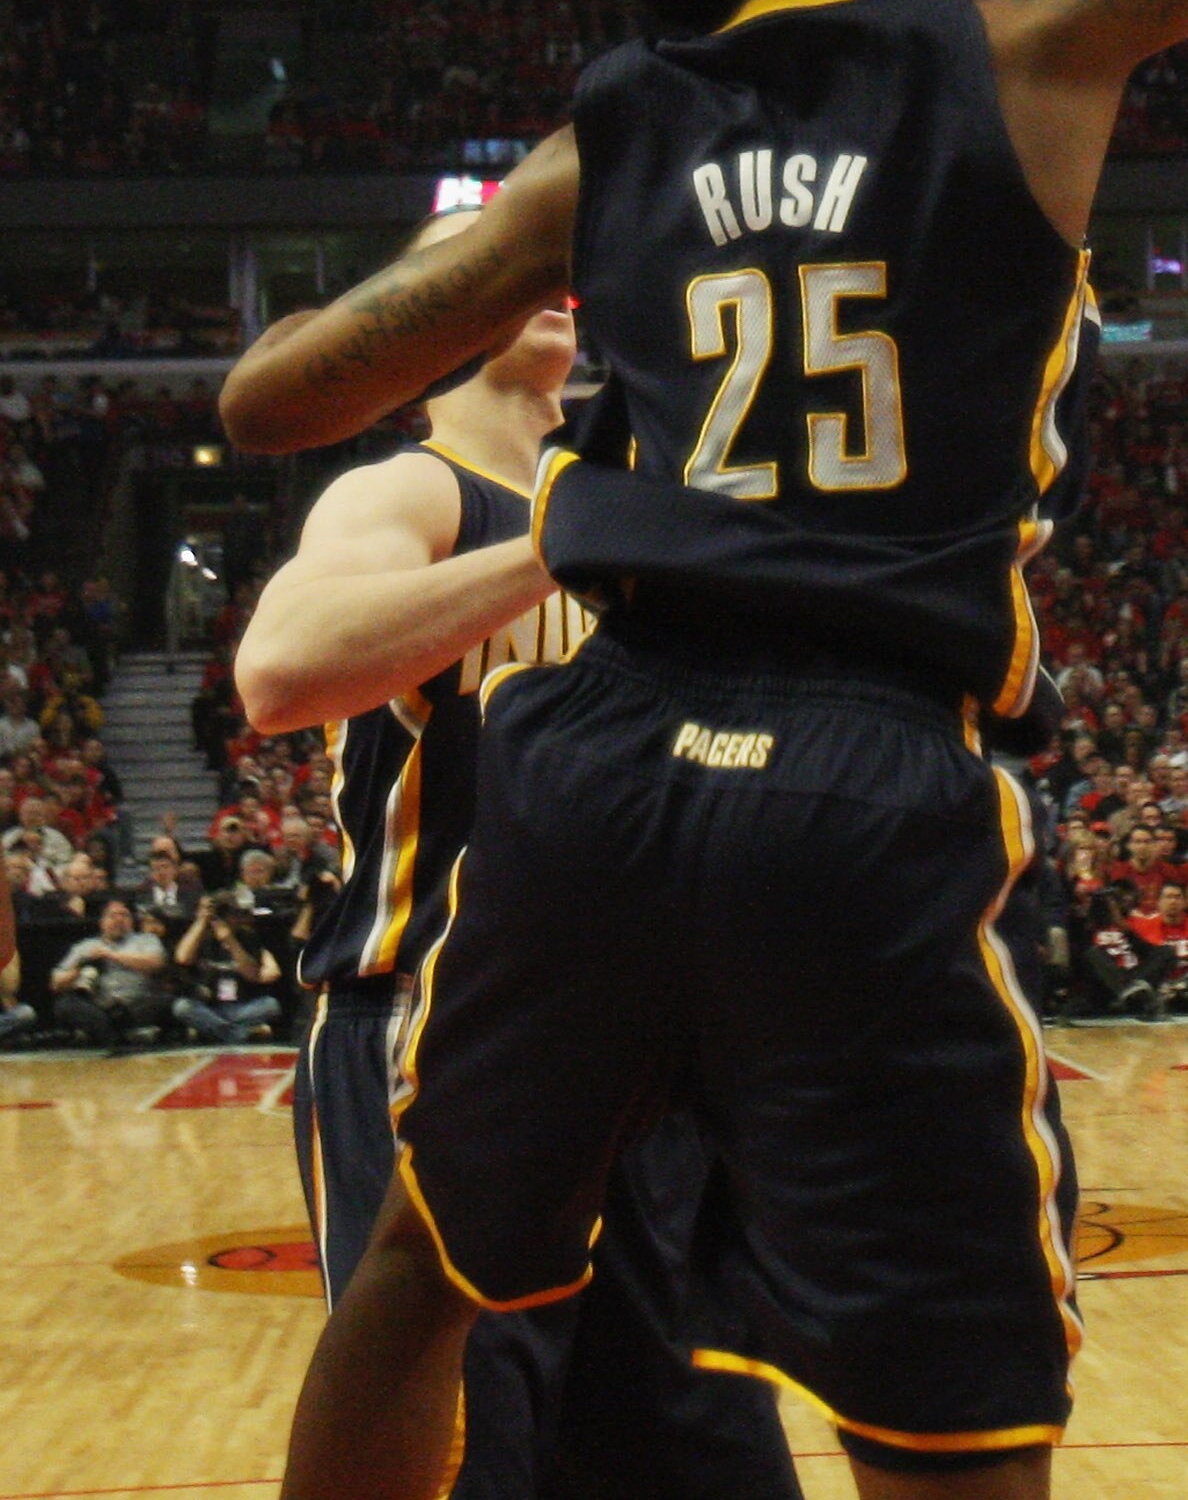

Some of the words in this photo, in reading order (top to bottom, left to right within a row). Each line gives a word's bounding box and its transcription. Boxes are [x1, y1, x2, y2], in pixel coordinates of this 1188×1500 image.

[693, 149, 868, 247] RUSH
[683, 260, 909, 502] 25
[672, 721, 775, 769] PACERS
